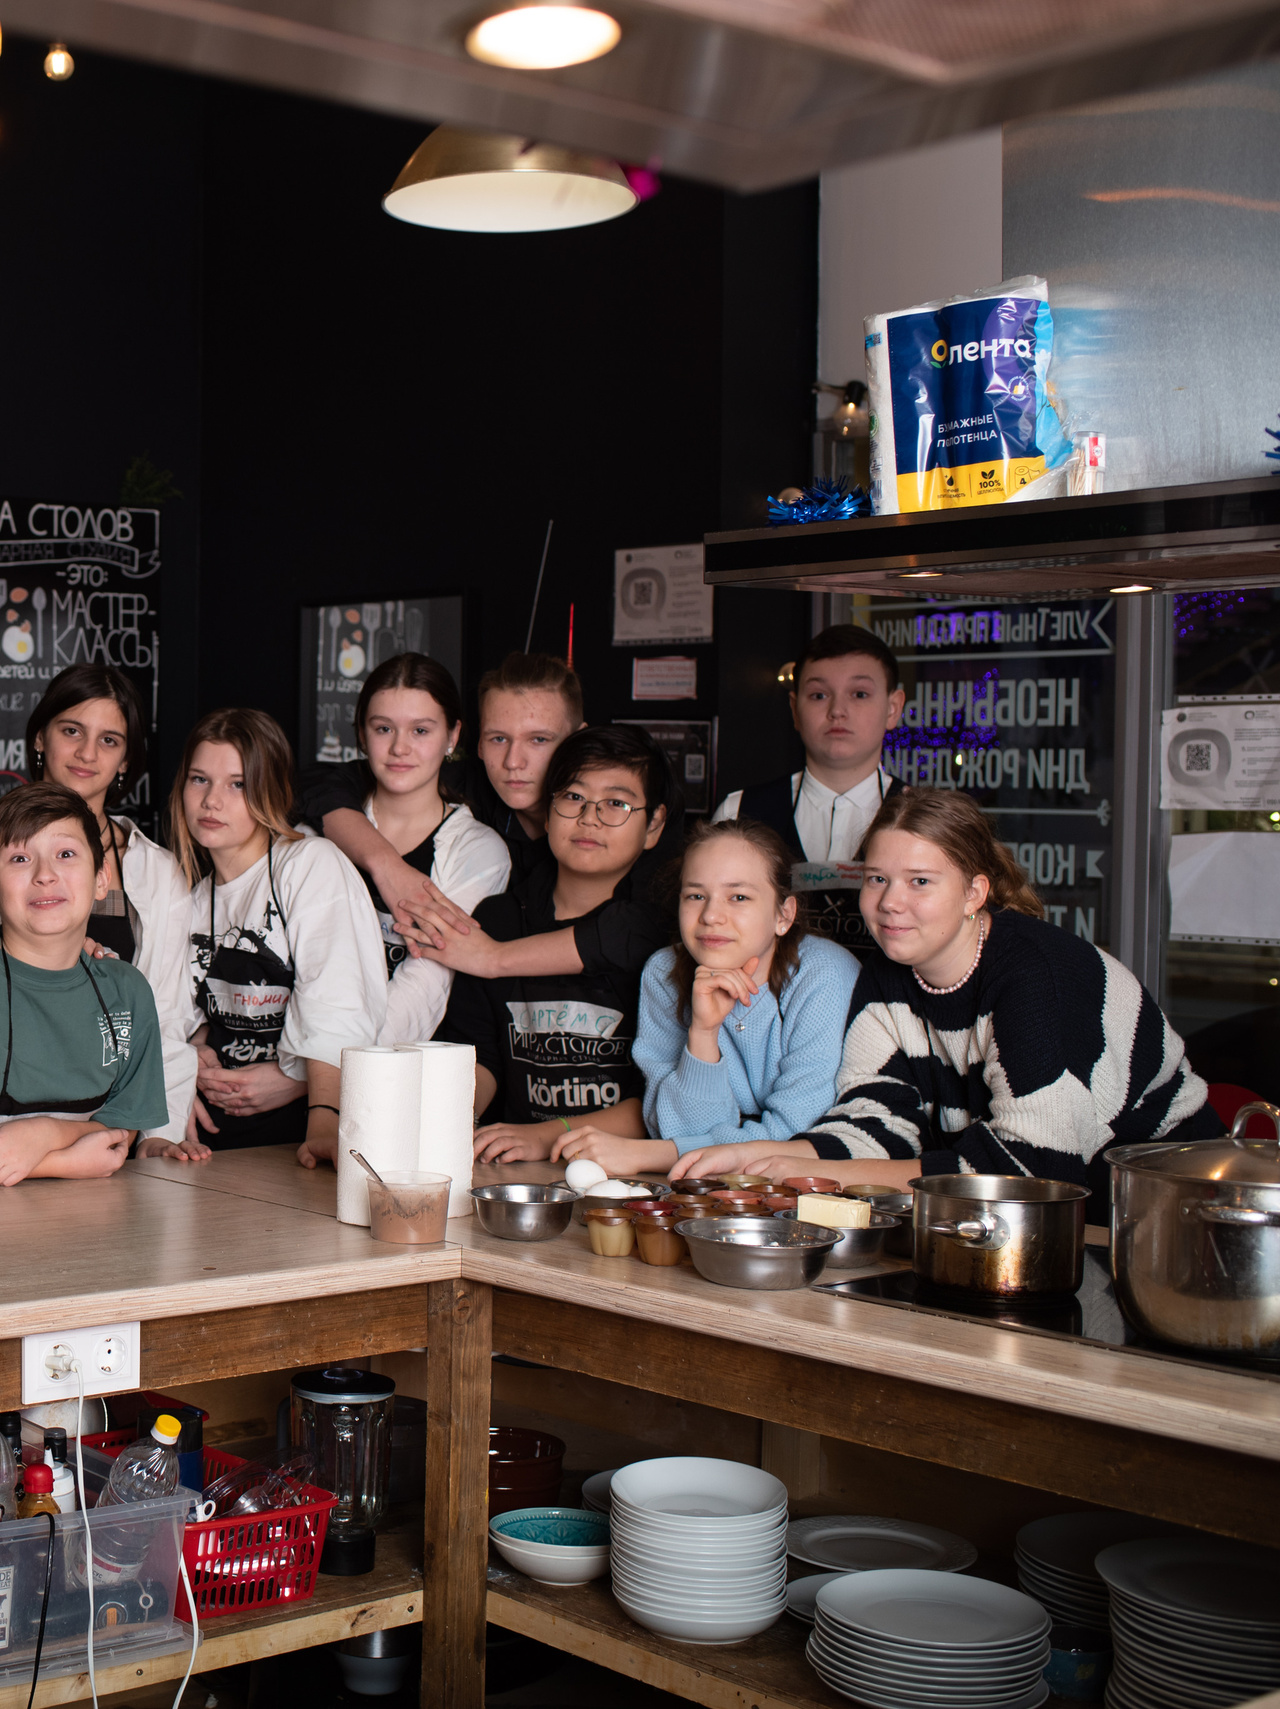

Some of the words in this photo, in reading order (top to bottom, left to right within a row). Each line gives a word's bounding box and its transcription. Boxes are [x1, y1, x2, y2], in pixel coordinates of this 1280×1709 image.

[938, 413, 994, 434] БУМАЖНЫЕ
[936, 429, 998, 448] ПОЛОТЕНЦА
[978, 479, 1001, 489] 100%
[1019, 477, 1027, 485] 4
[28, 502, 134, 542] СТОЛОВ
[526, 1073, 621, 1109] körting
